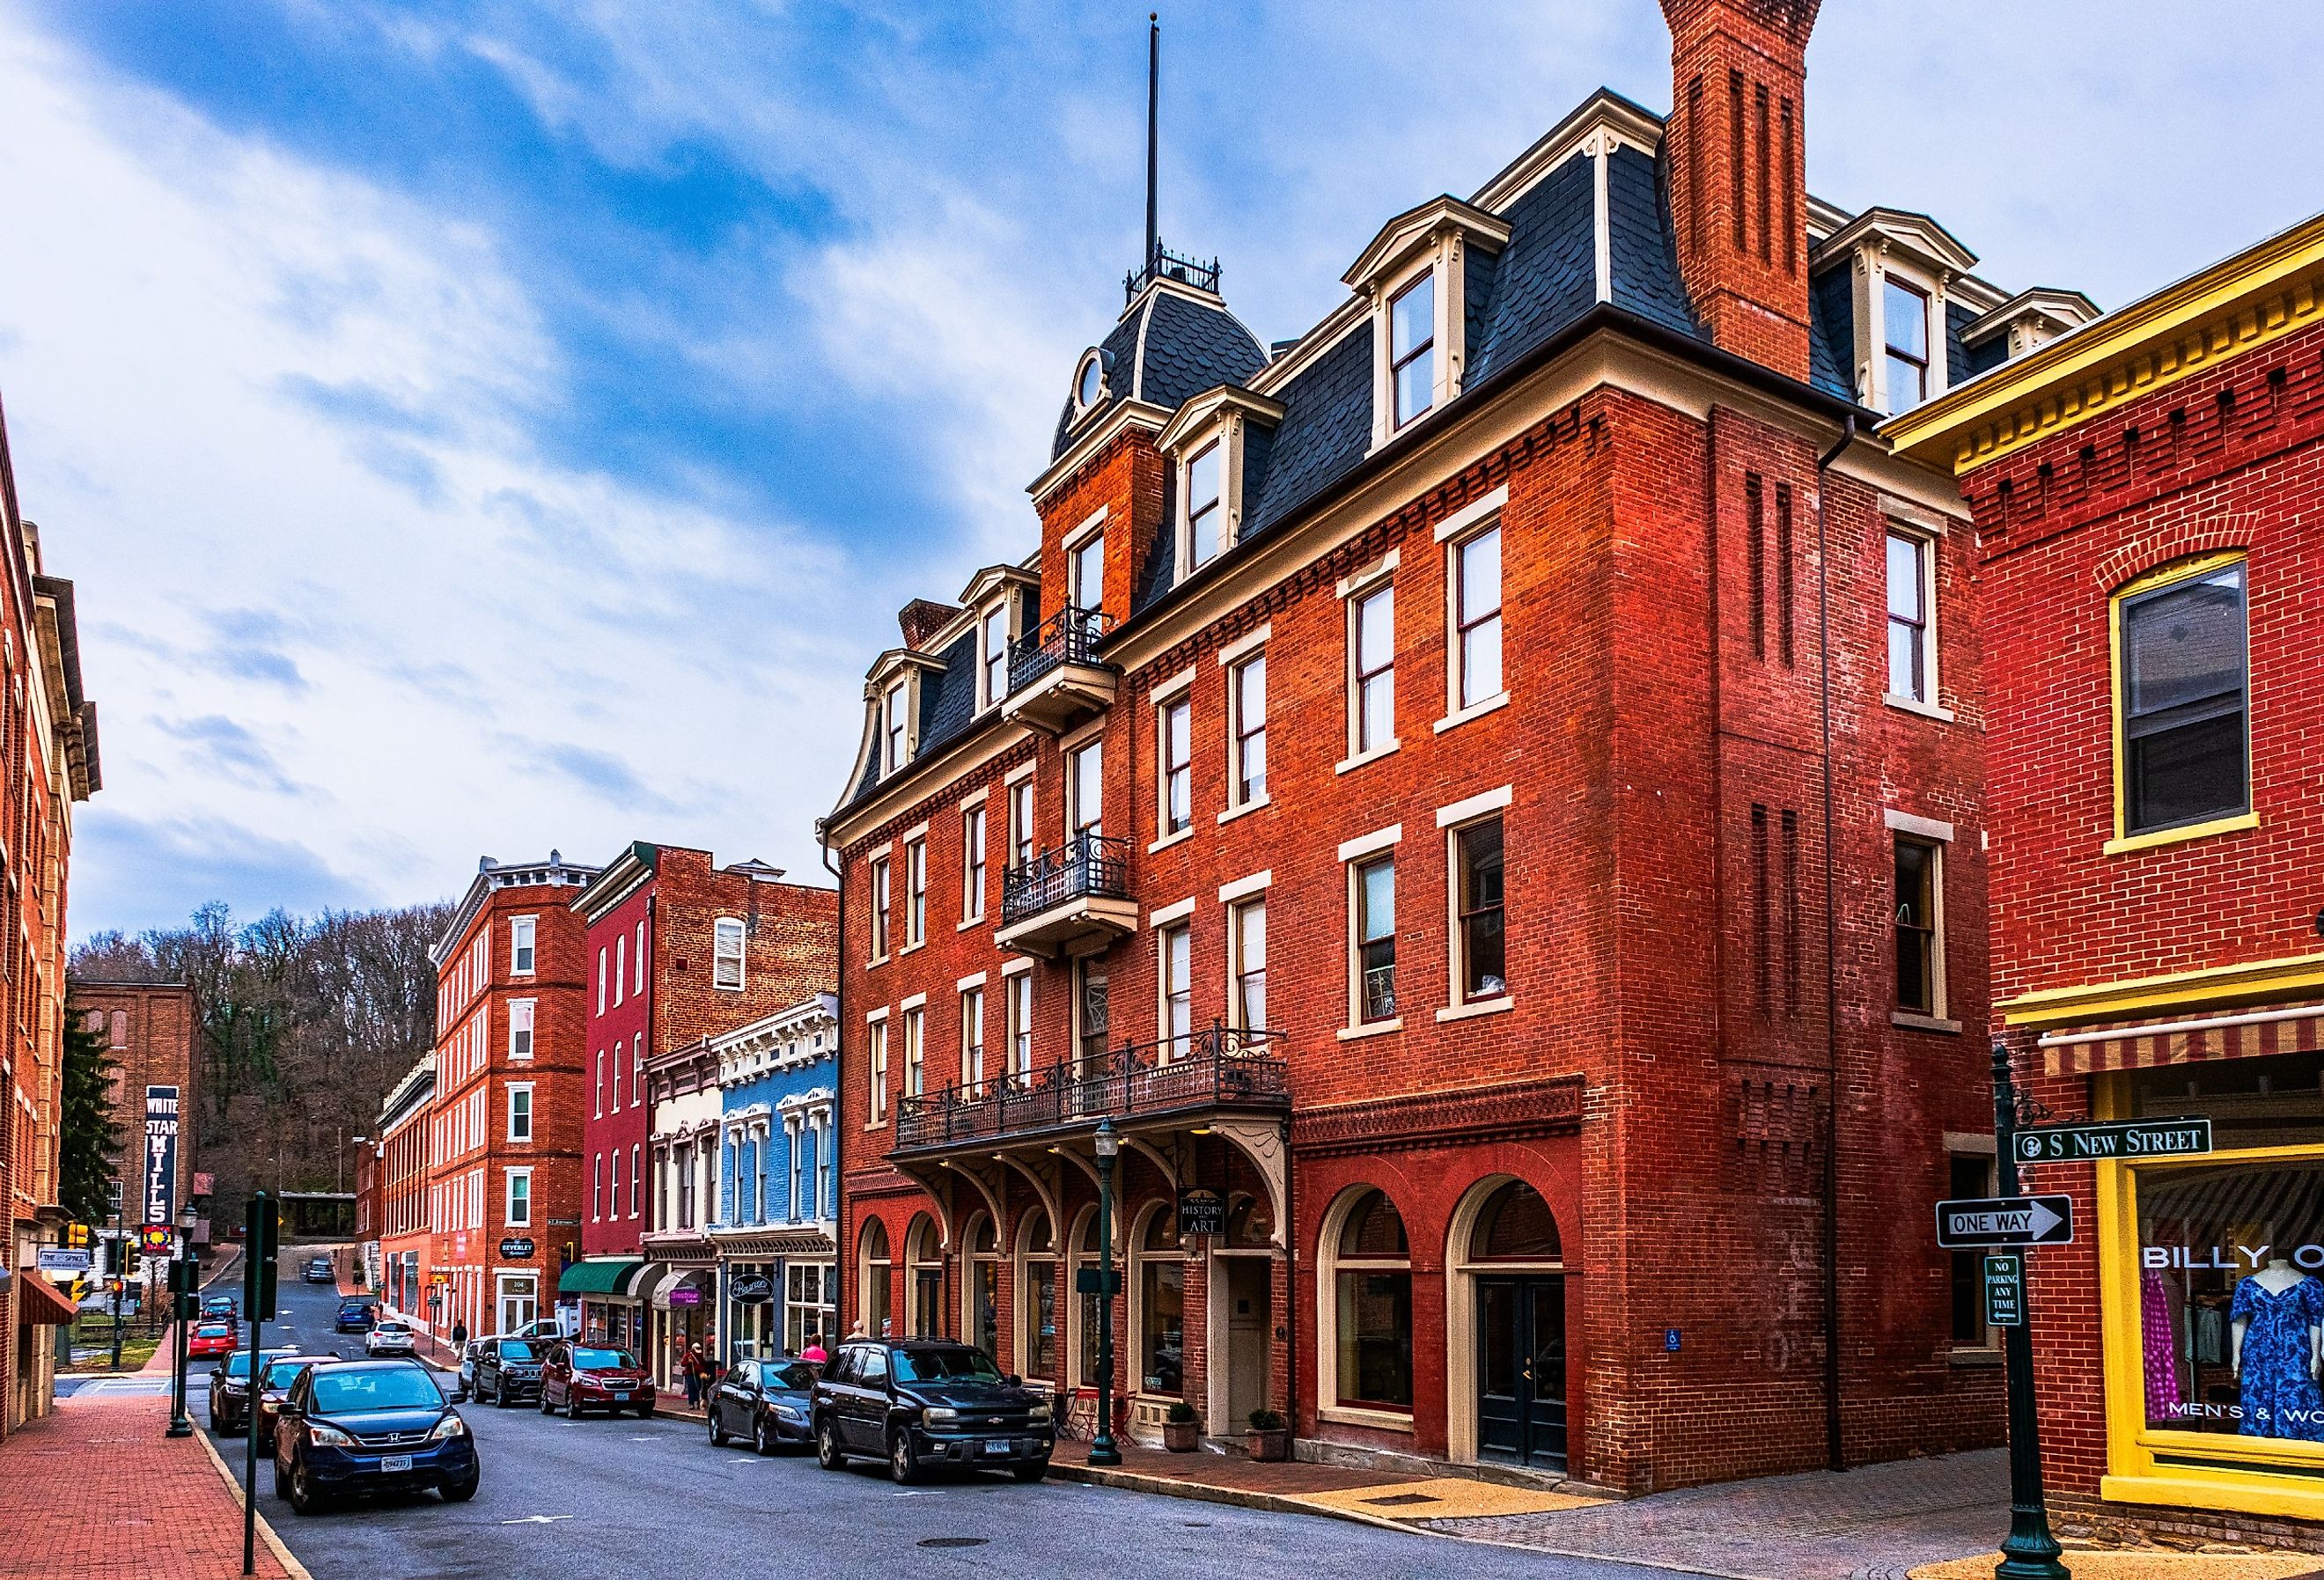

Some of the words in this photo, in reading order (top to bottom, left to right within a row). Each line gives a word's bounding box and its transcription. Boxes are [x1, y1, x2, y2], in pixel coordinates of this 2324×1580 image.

[147, 1099, 179, 1114] WHITE
[145, 1121, 178, 1135] STAR
[2049, 1134, 2063, 1157] S
[149, 1135, 166, 1223] MILLS
[1182, 1205, 1223, 1215] HISTORY
[1190, 1220, 1217, 1232] ART
[1954, 1215, 1989, 1232] ONE
[1996, 1212, 2032, 1231] WAY
[2144, 1245, 2269, 1268] BILLY
[1995, 1262, 2009, 1272] NO
[1987, 1275, 2018, 1284] PARKING
[1995, 1287, 2011, 1297] ANY
[1992, 1299, 2016, 1309] TIME
[2168, 1401, 2245, 1419] MEN'S
[2255, 1407, 2271, 1420] &
